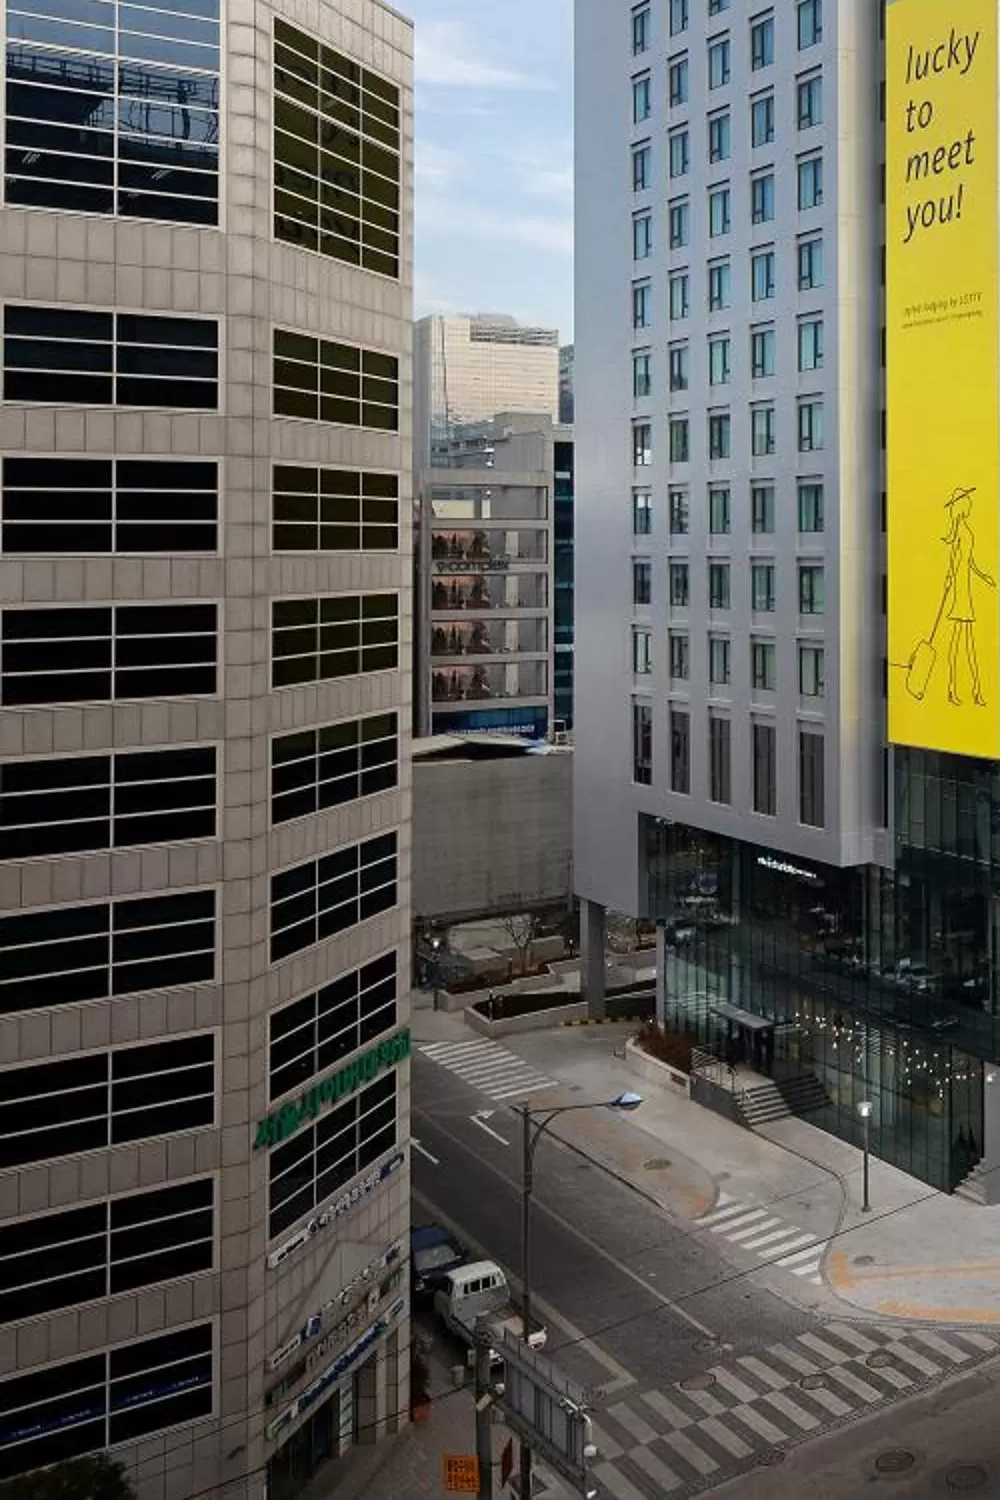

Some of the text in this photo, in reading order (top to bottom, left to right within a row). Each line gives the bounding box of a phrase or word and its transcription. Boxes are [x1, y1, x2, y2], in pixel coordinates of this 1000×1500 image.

[905, 28, 980, 85] lucky
[906, 99, 933, 133] to
[906, 130, 976, 183] meet
[903, 183, 964, 244] you!
